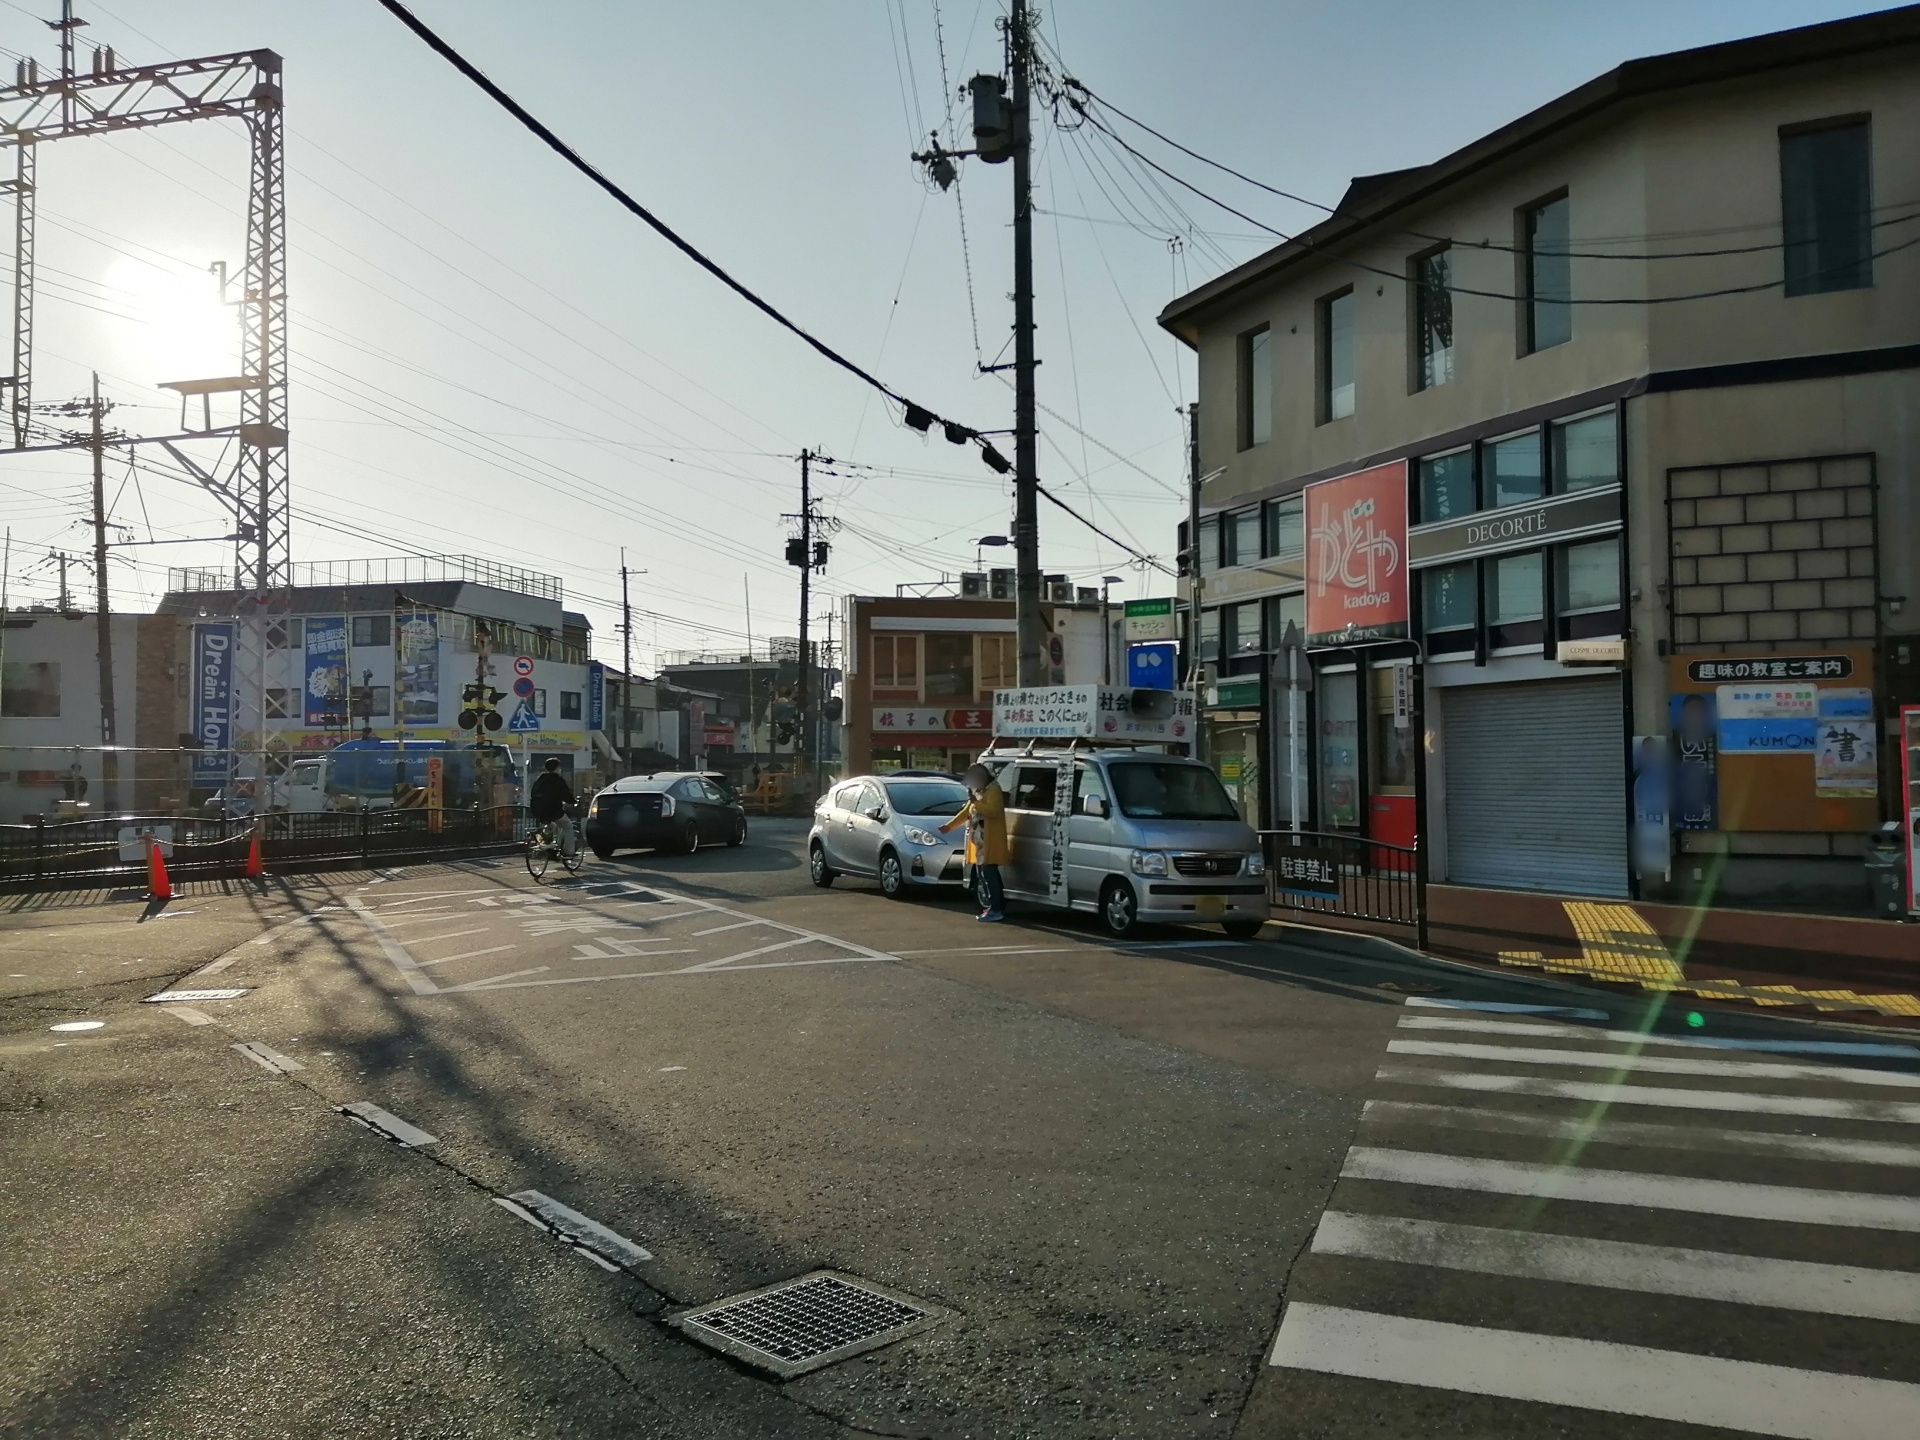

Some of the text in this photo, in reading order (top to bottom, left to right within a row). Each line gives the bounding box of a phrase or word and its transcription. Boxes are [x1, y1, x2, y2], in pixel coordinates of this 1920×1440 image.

[1467, 509, 1547, 544] DECORTÉ
[1344, 591, 1391, 610] kadoya
[205, 634, 229, 700] Dream
[1698, 660, 1842, 679] 趣味の教室ご案内
[1098, 692, 1130, 711] 社会
[203, 706, 228, 767] Home
[1749, 733, 1815, 748] KUMON
[1830, 727, 1862, 763] 書
[1280, 856, 1335, 884] 駐車禁止
